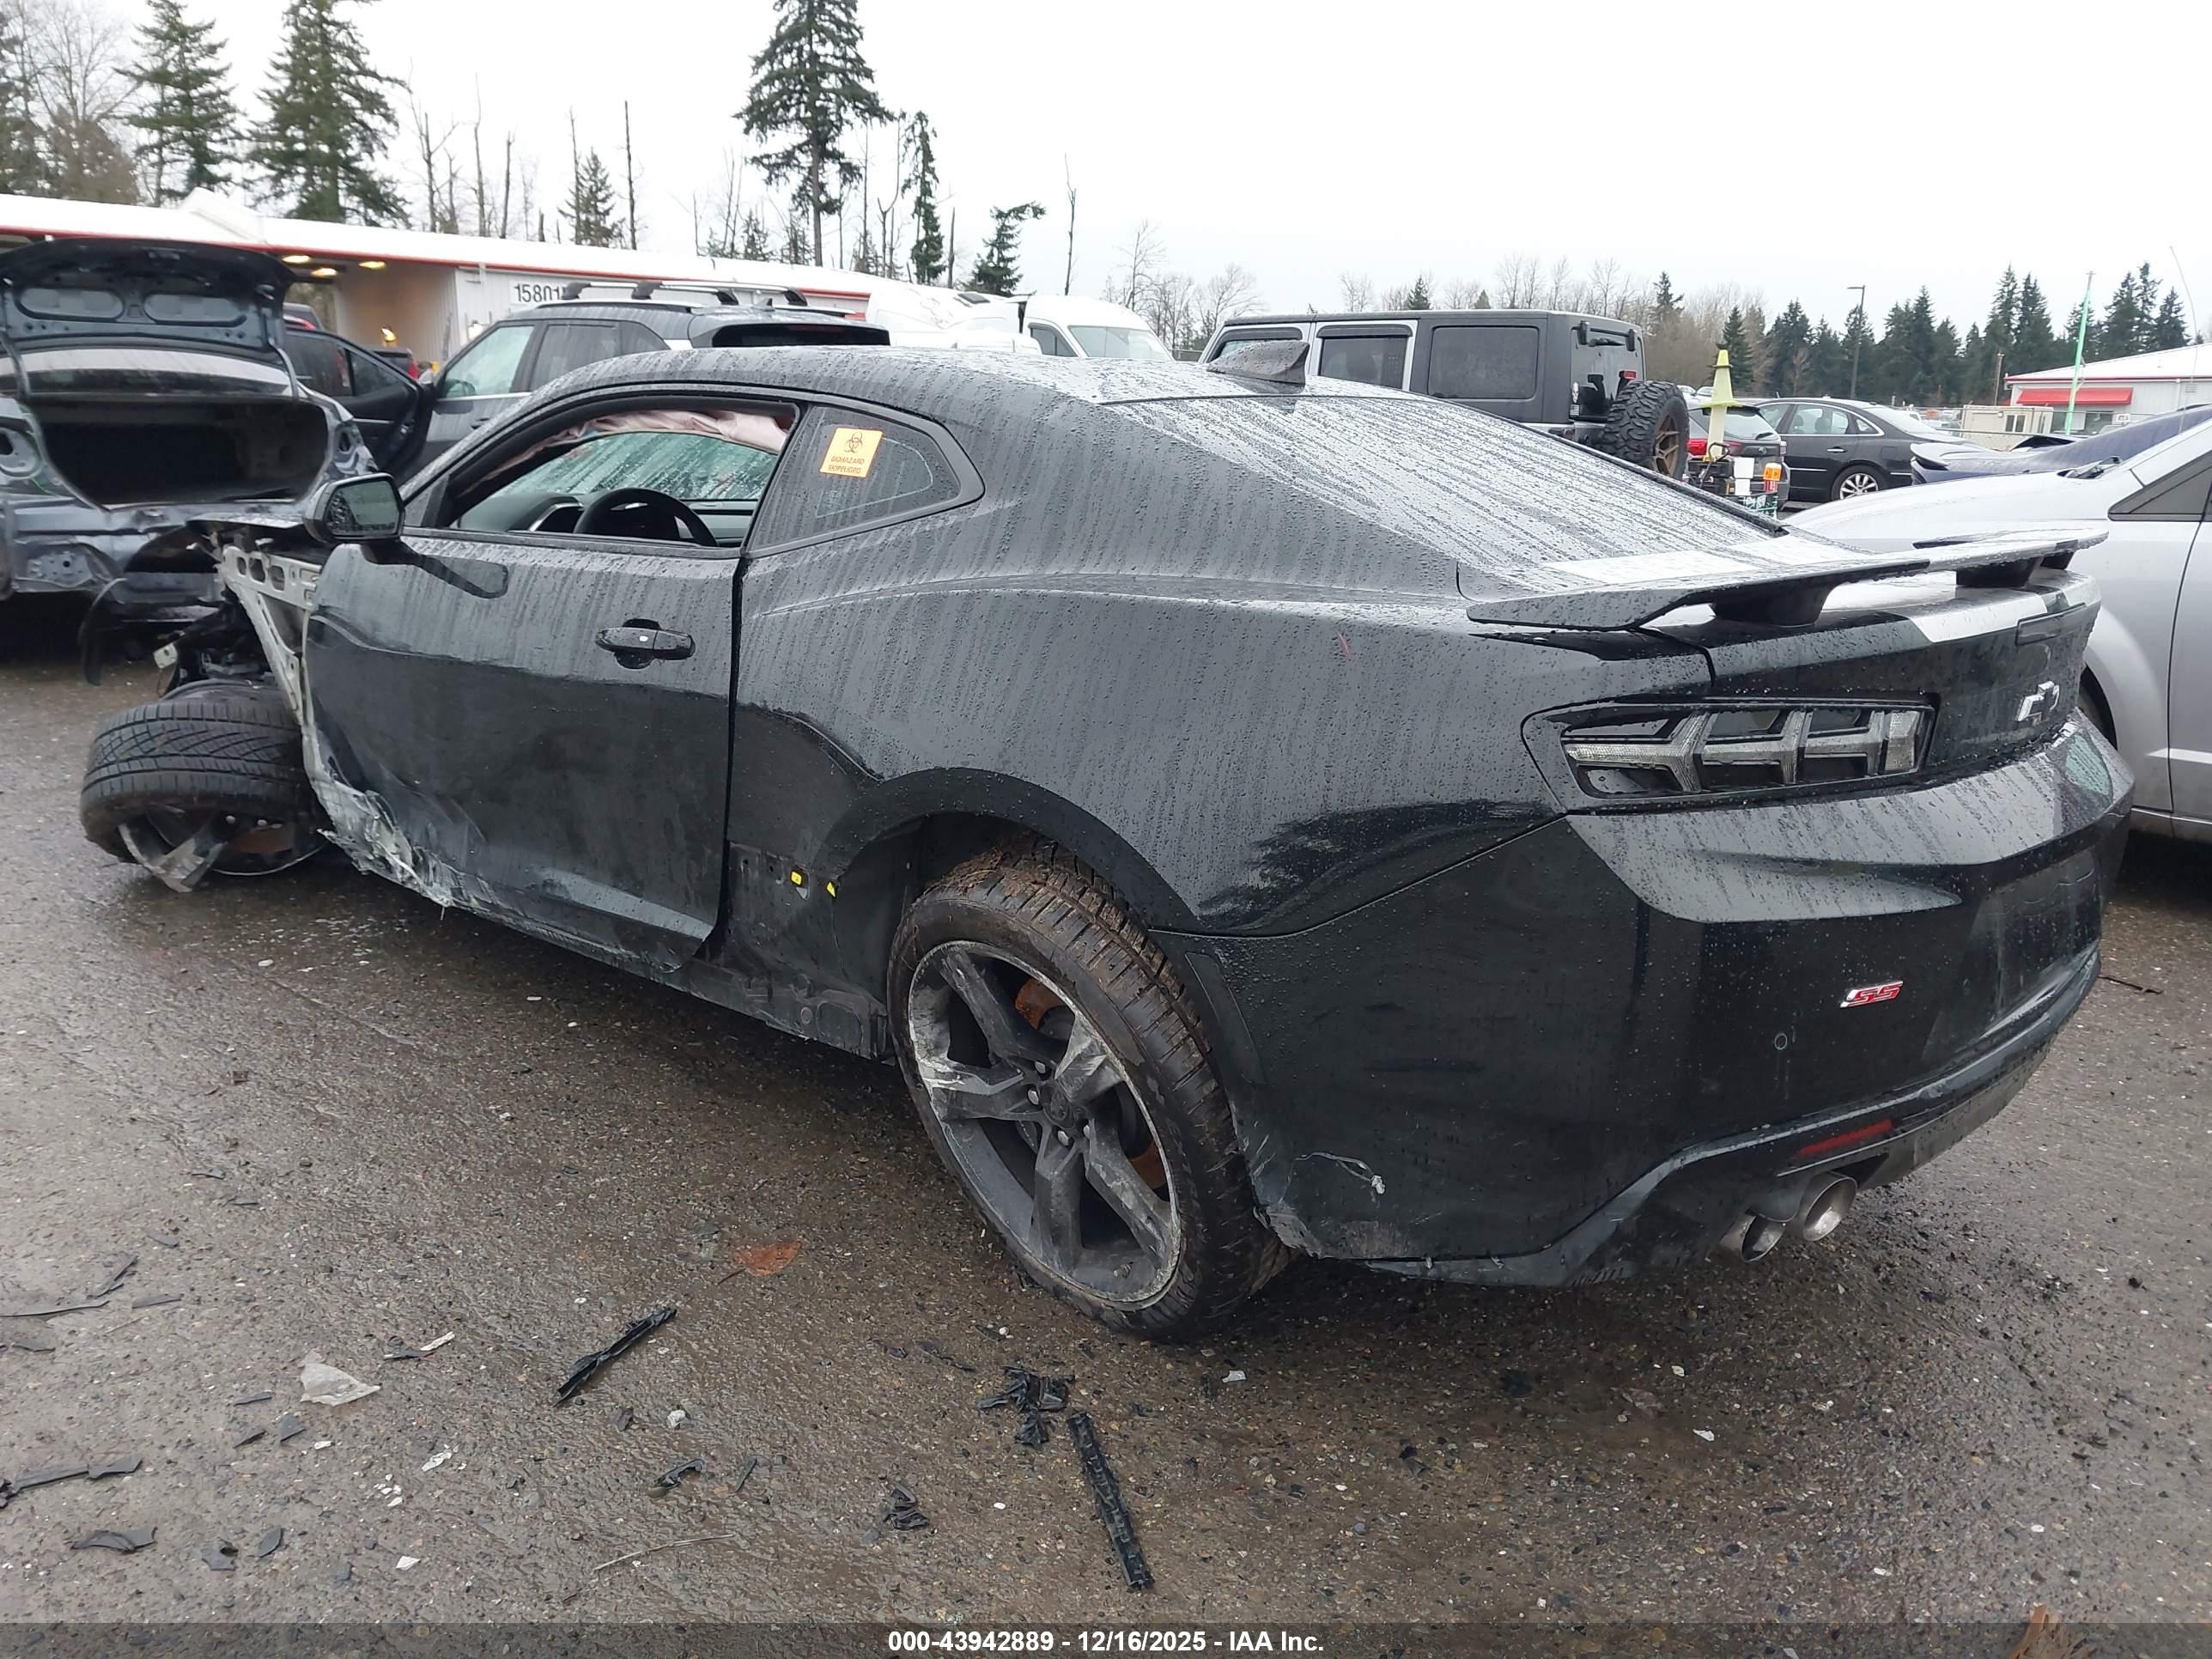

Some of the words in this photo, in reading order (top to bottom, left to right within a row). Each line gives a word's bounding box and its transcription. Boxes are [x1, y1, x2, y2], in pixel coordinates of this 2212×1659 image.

[514, 283, 560, 302] 15801
[830, 456, 865, 465] BIOHAZARD
[1840, 980, 1904, 1008] SS
